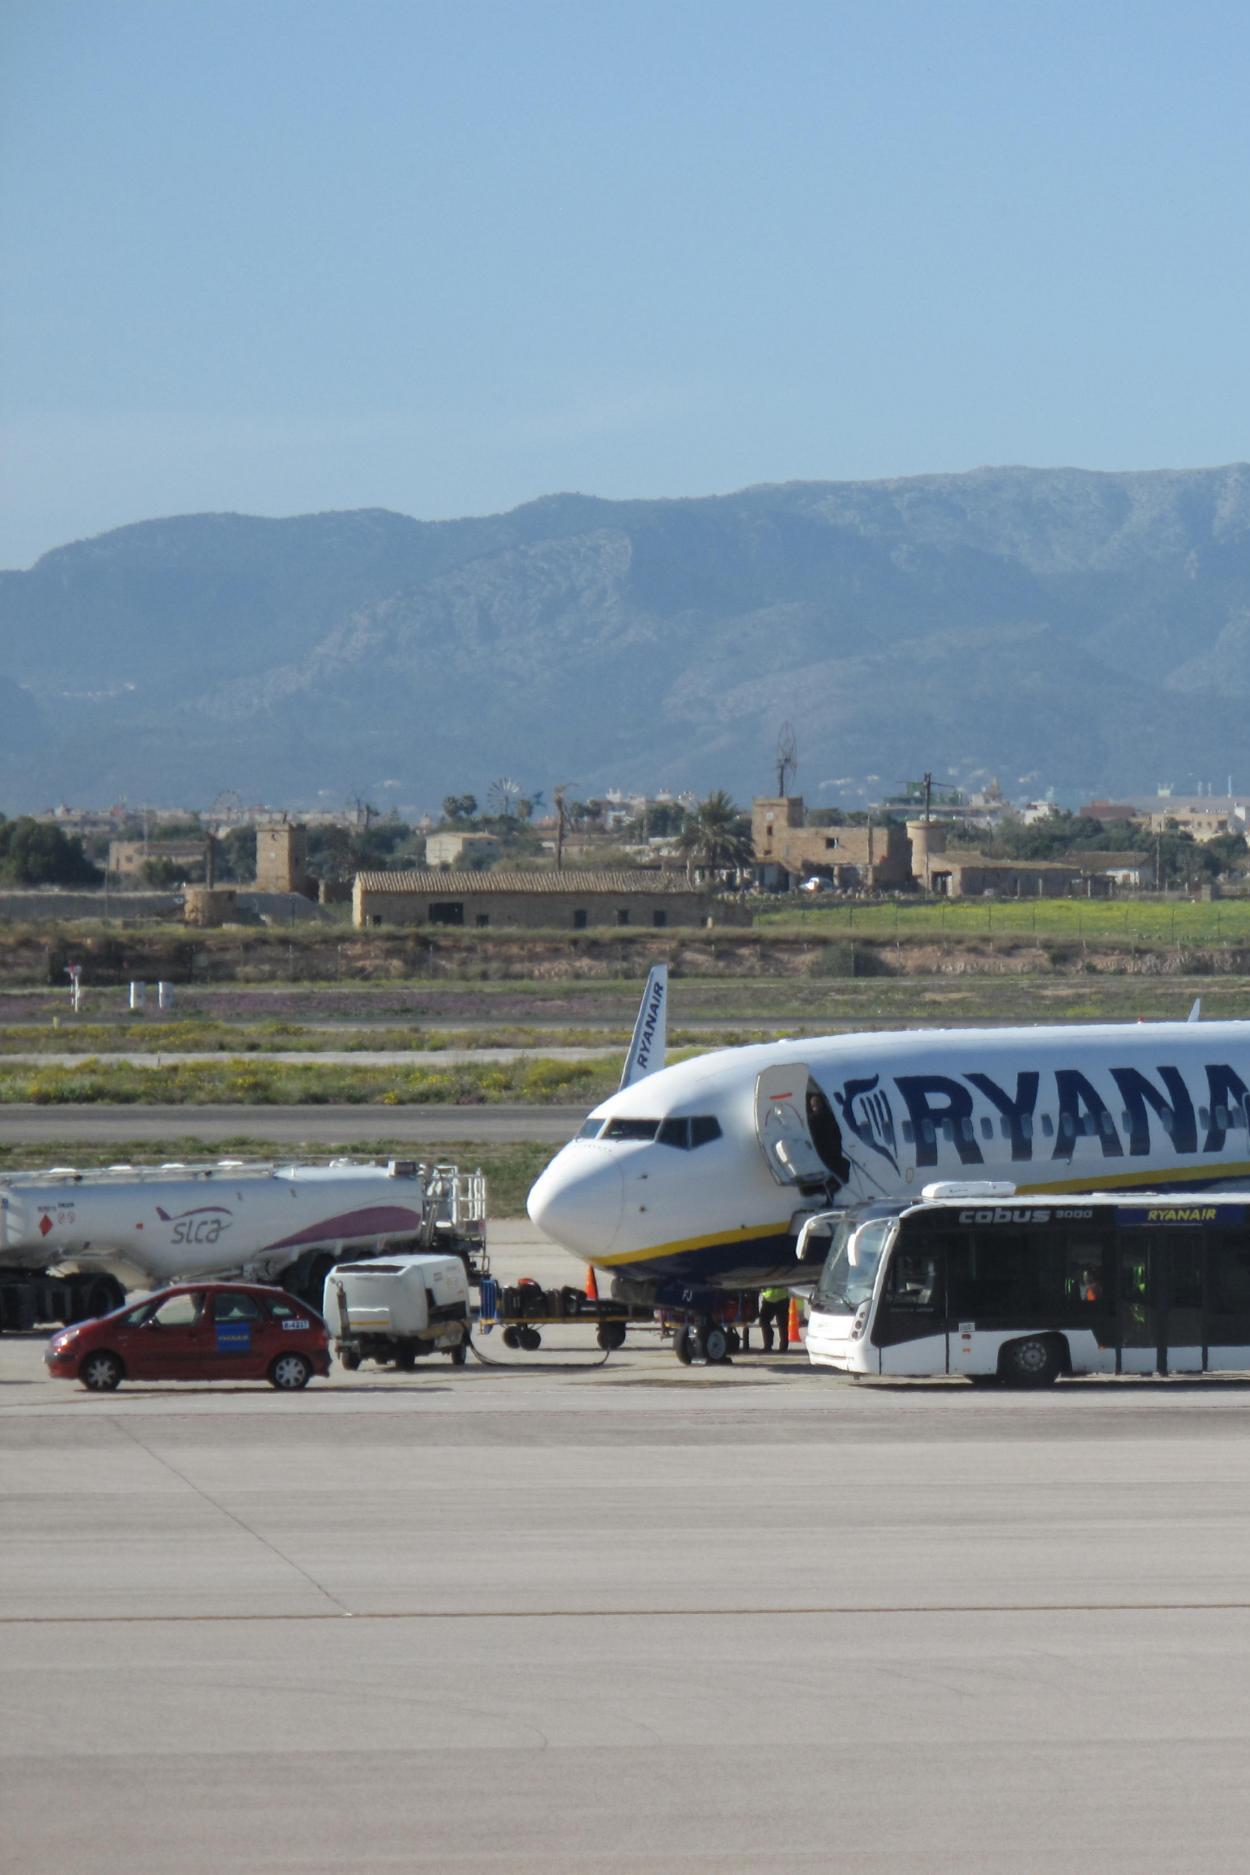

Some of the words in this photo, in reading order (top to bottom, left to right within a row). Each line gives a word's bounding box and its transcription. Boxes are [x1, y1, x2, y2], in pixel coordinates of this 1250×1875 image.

[636, 981, 664, 1070] RYANAIR
[958, 1207, 1051, 1224] cobus
[1055, 1209, 1094, 1219] 3000
[1147, 1208, 1217, 1221] RYANAIR
